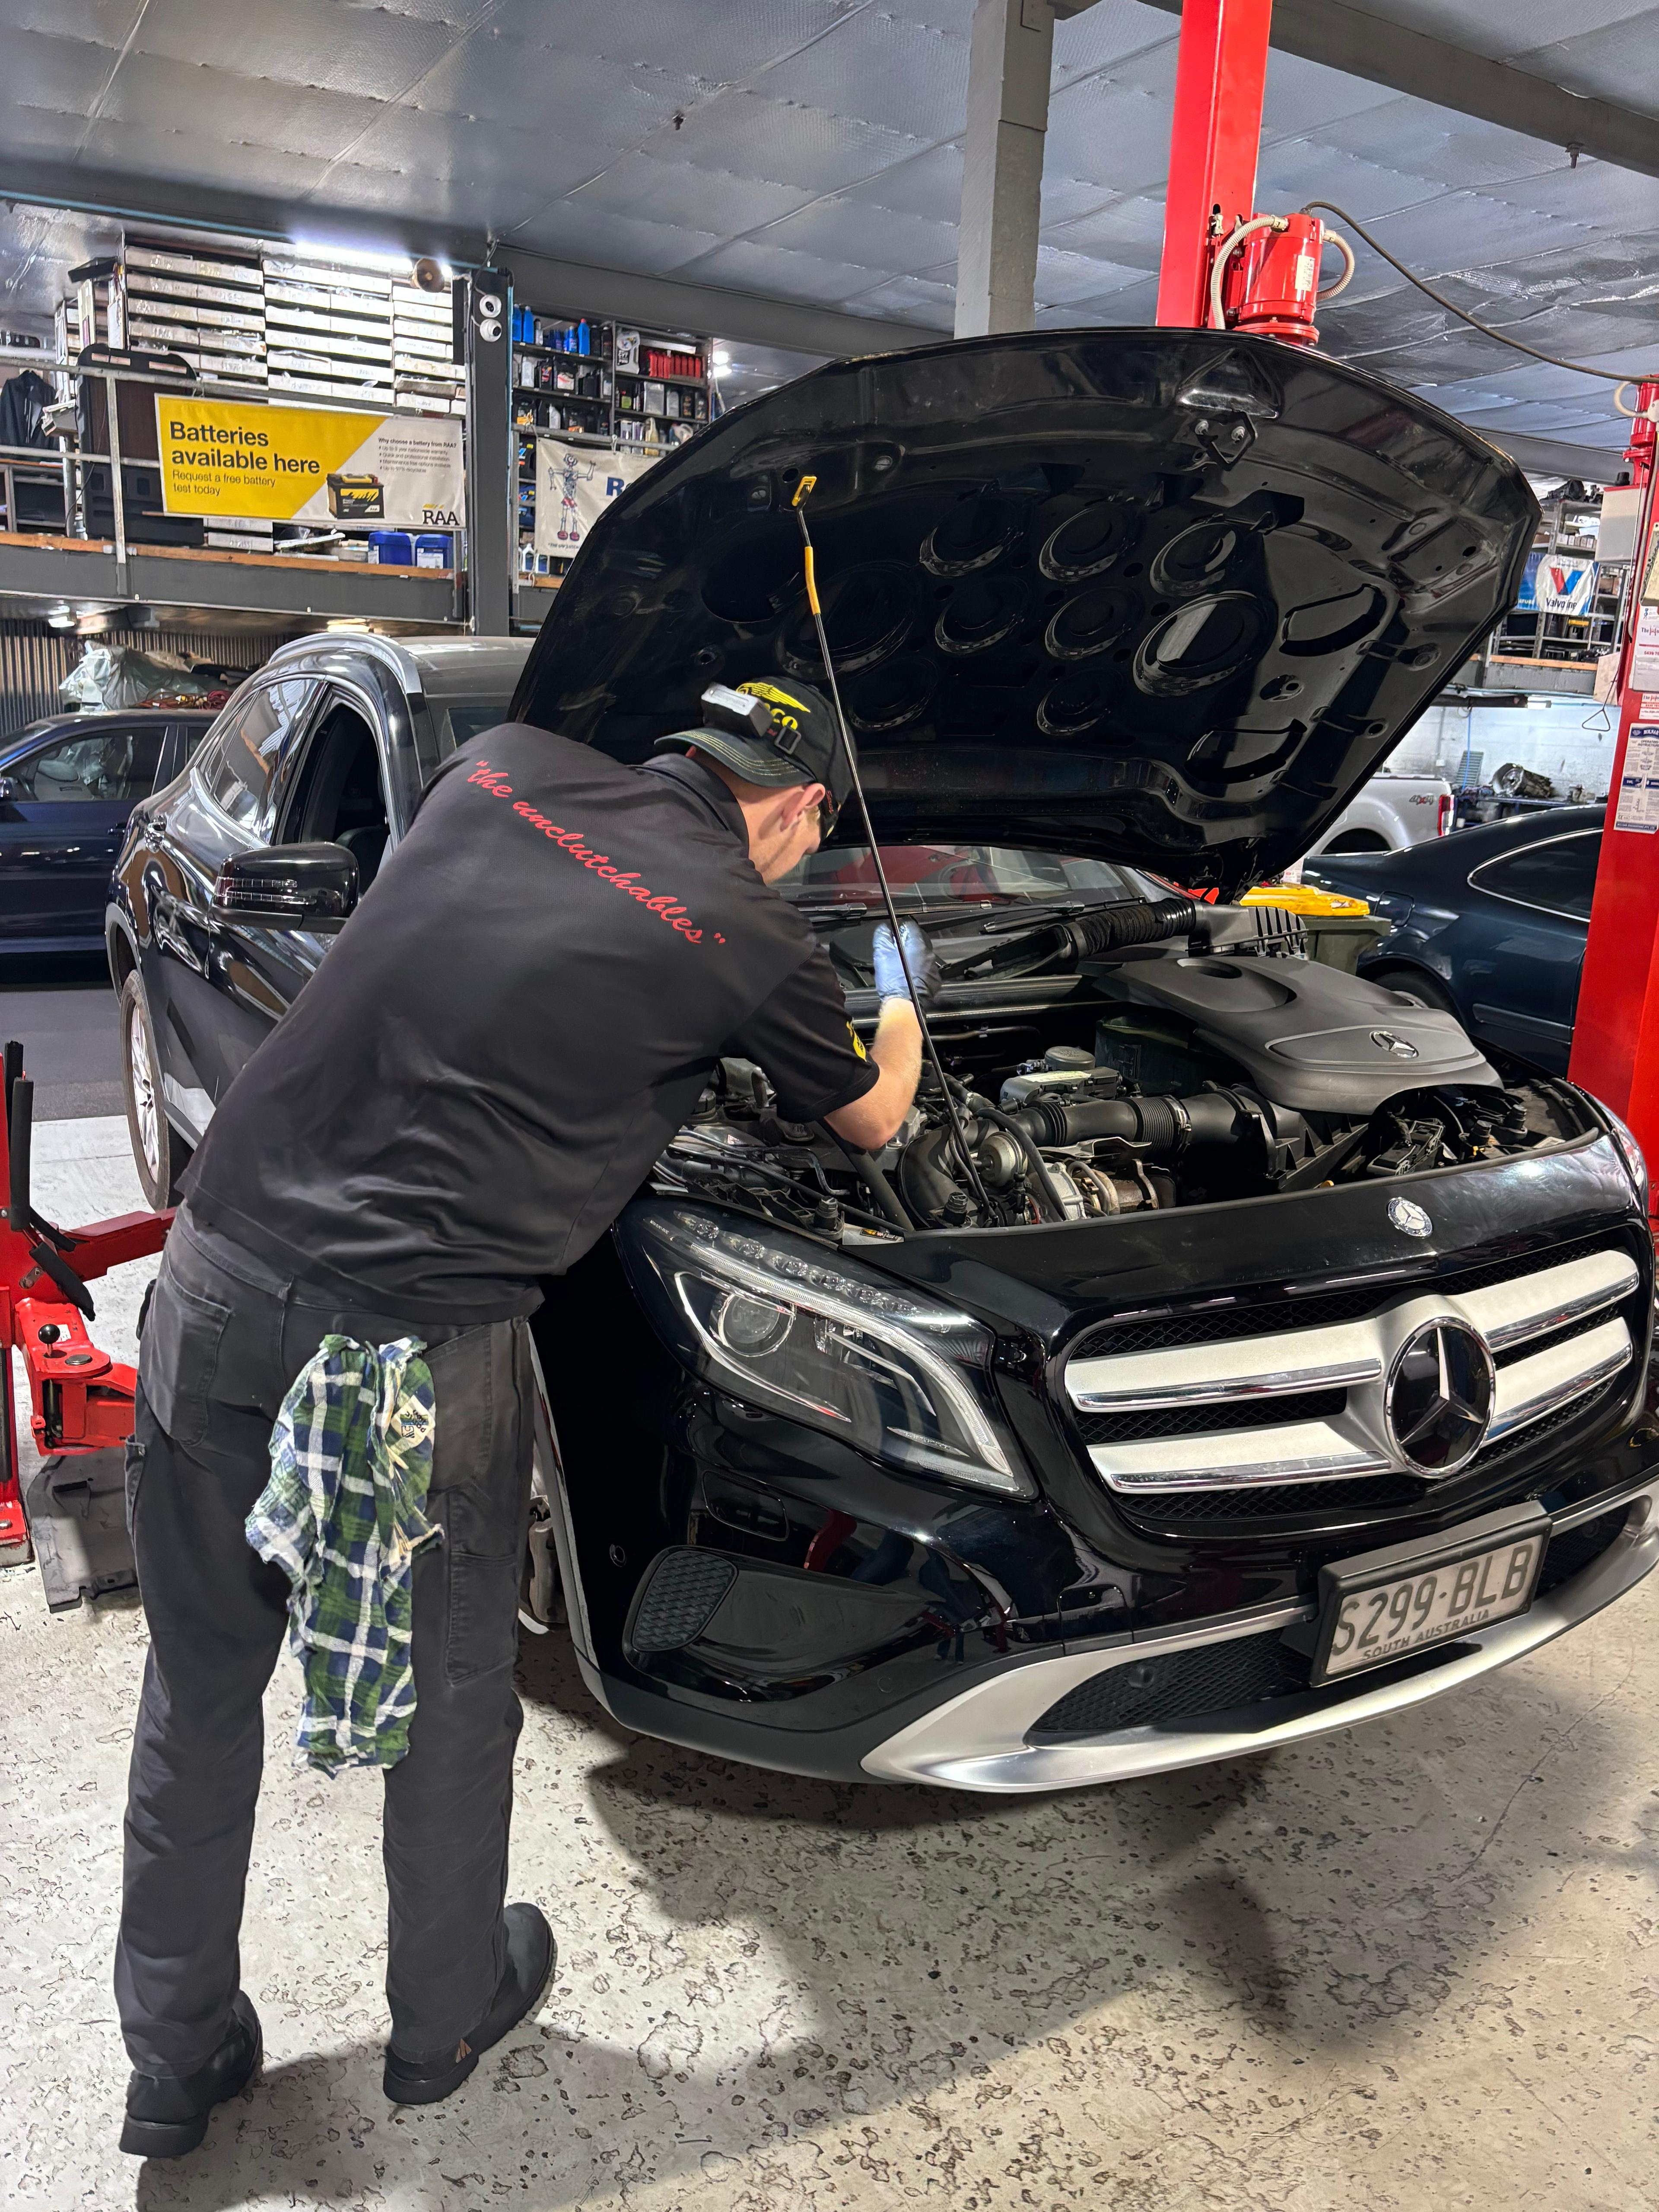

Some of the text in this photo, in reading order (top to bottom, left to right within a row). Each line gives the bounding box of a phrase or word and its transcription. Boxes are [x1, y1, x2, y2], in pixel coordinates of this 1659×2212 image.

[170, 421, 269, 447] Batteries
[172, 448, 320, 474] available here
[173, 470, 211, 483] Request
[224, 474, 241, 483] free
[244, 475, 276, 487] battery
[173, 483, 220, 496] test today
[422, 510, 460, 526] RAA
[1546, 597, 1577, 610] Valvoine
[1363, 1609, 1489, 1661] SOUTH AUSTRALIA
